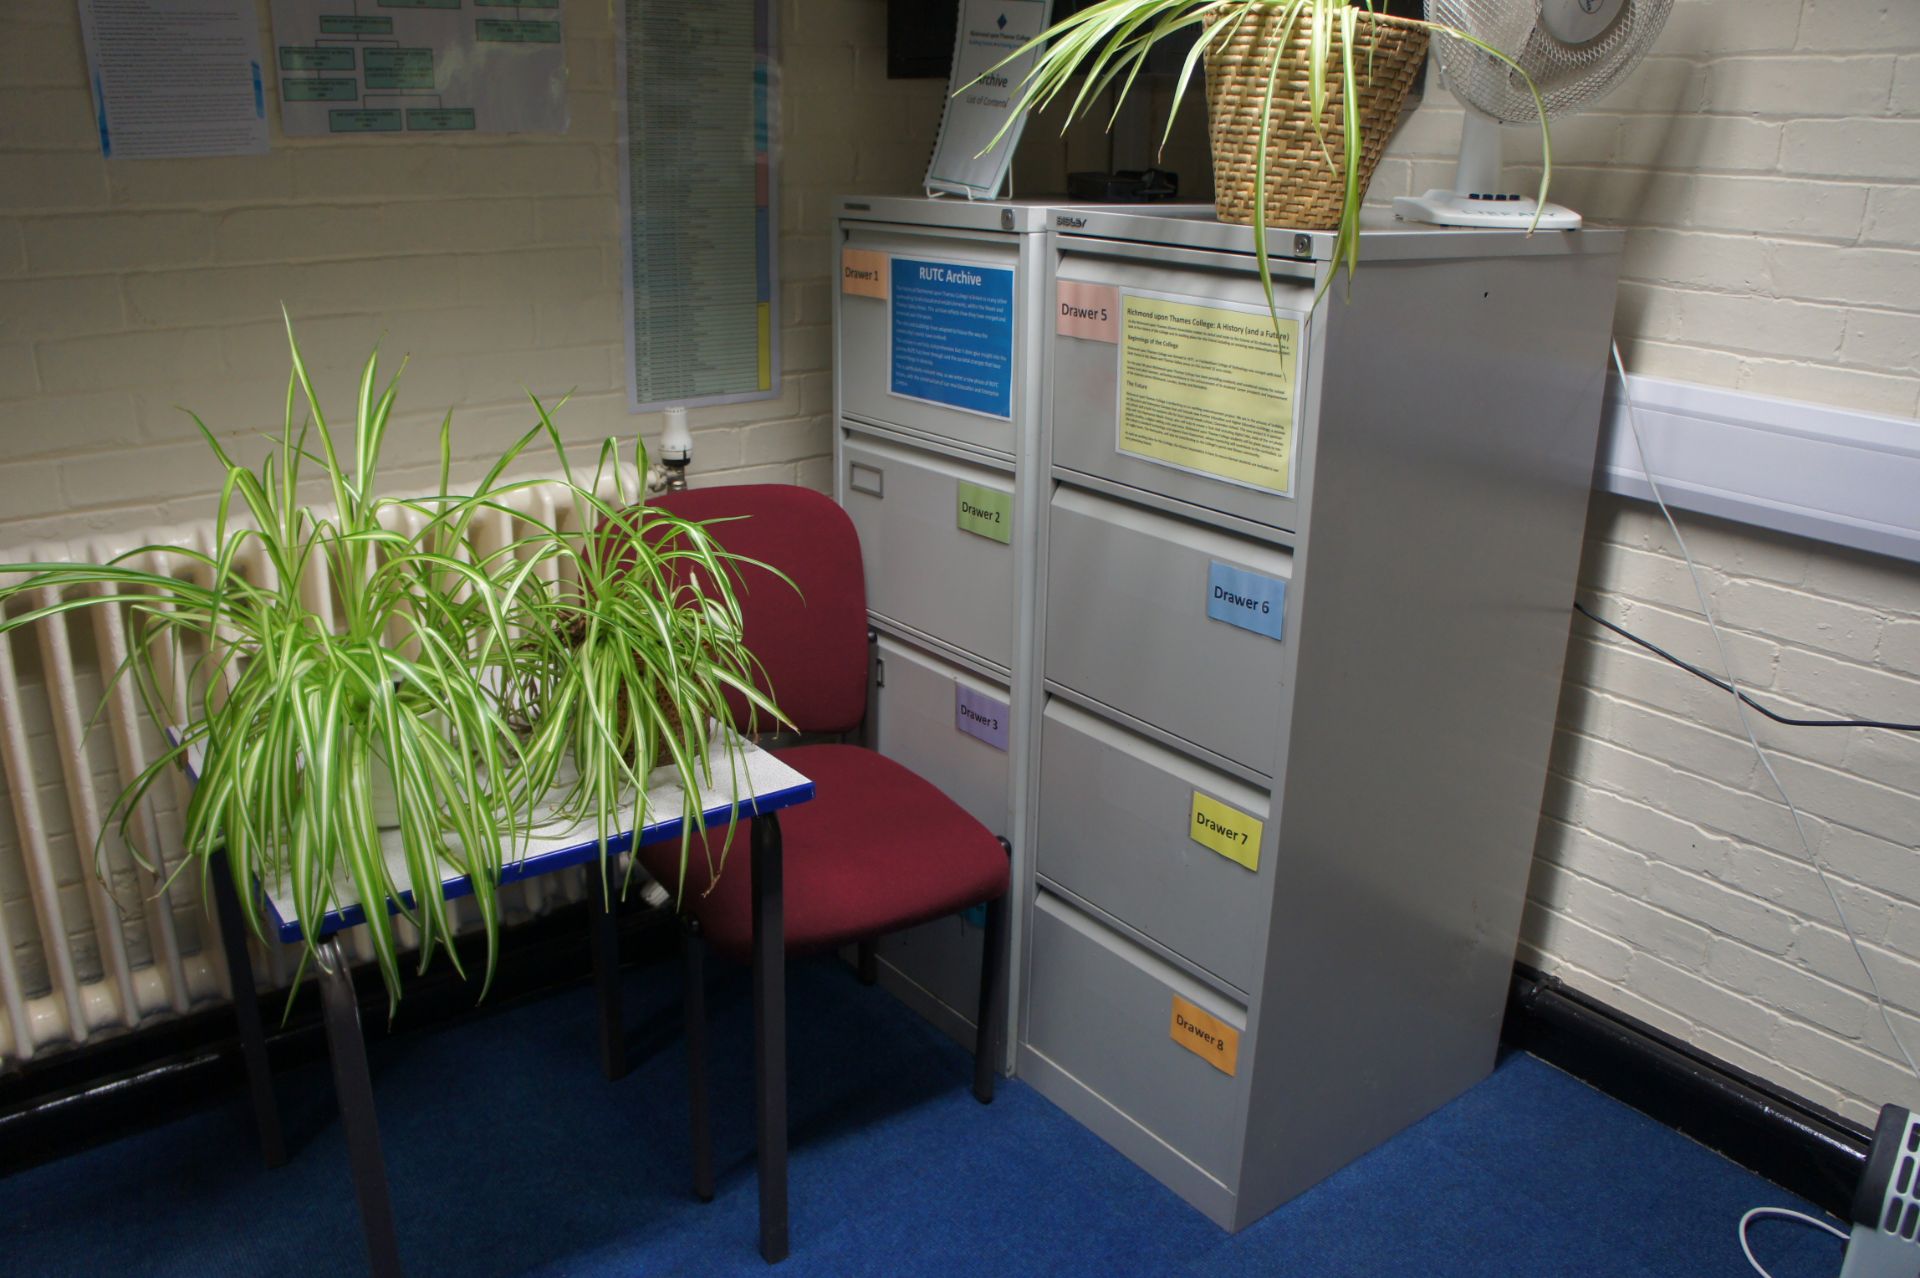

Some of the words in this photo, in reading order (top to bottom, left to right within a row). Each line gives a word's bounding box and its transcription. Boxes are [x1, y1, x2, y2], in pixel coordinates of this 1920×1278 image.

[845, 266, 872, 280] Drawer
[874, 271, 878, 282] 1
[919, 266, 944, 282] RUTC
[946, 270, 982, 286] Archive
[1061, 303, 1099, 320] Drawer
[1100, 308, 1108, 321] 5
[1127, 308, 1153, 319] Richmond
[1154, 313, 1168, 322] upon
[1169, 314, 1191, 325] Thames
[1192, 318, 1216, 329] College:
[1223, 324, 1244, 334] History
[1245, 327, 1258, 336] (and
[1162, 340, 1178, 349] College
[962, 502, 993, 520] Drawer
[994, 511, 1000, 523] 2
[1214, 586, 1258, 610] Drawer
[1261, 601, 1270, 614] 6
[960, 704, 991, 727] Drawer
[992, 719, 998, 730] 3
[1197, 812, 1238, 840] Drawer
[1241, 832, 1248, 845] 7
[1176, 1014, 1215, 1044] Drawer
[1217, 1039, 1224, 1051] 8
